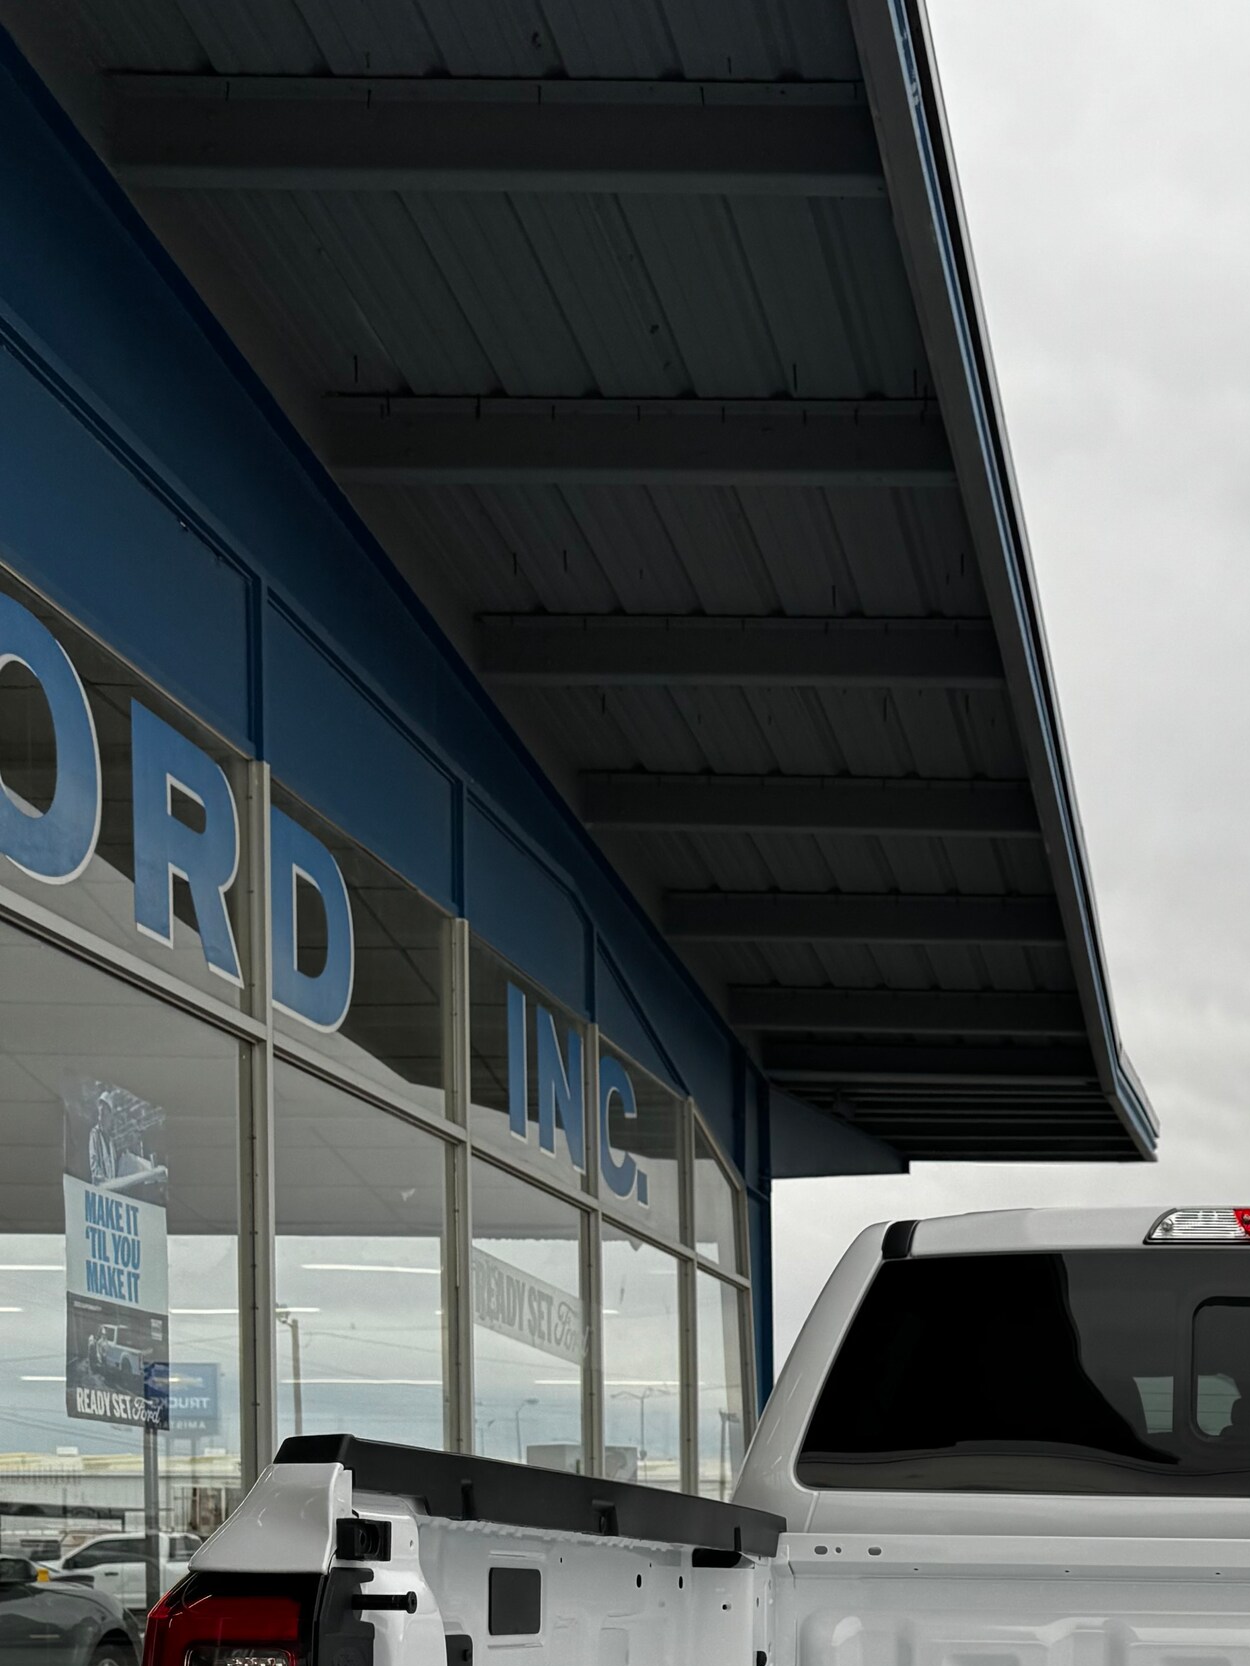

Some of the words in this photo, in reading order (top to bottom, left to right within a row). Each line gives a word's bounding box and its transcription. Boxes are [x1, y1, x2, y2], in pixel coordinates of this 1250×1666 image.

[507, 980, 649, 1208] INC.
[85, 1189, 124, 1232] MAKE
[125, 1203, 139, 1236] IT
[112, 1233, 141, 1270] YOU
[86, 1260, 126, 1301] MAKE
[127, 1270, 141, 1304] IT
[528, 1286, 553, 1344] SET
[76, 1387, 111, 1416] READY
[112, 1393, 131, 1419] SET
